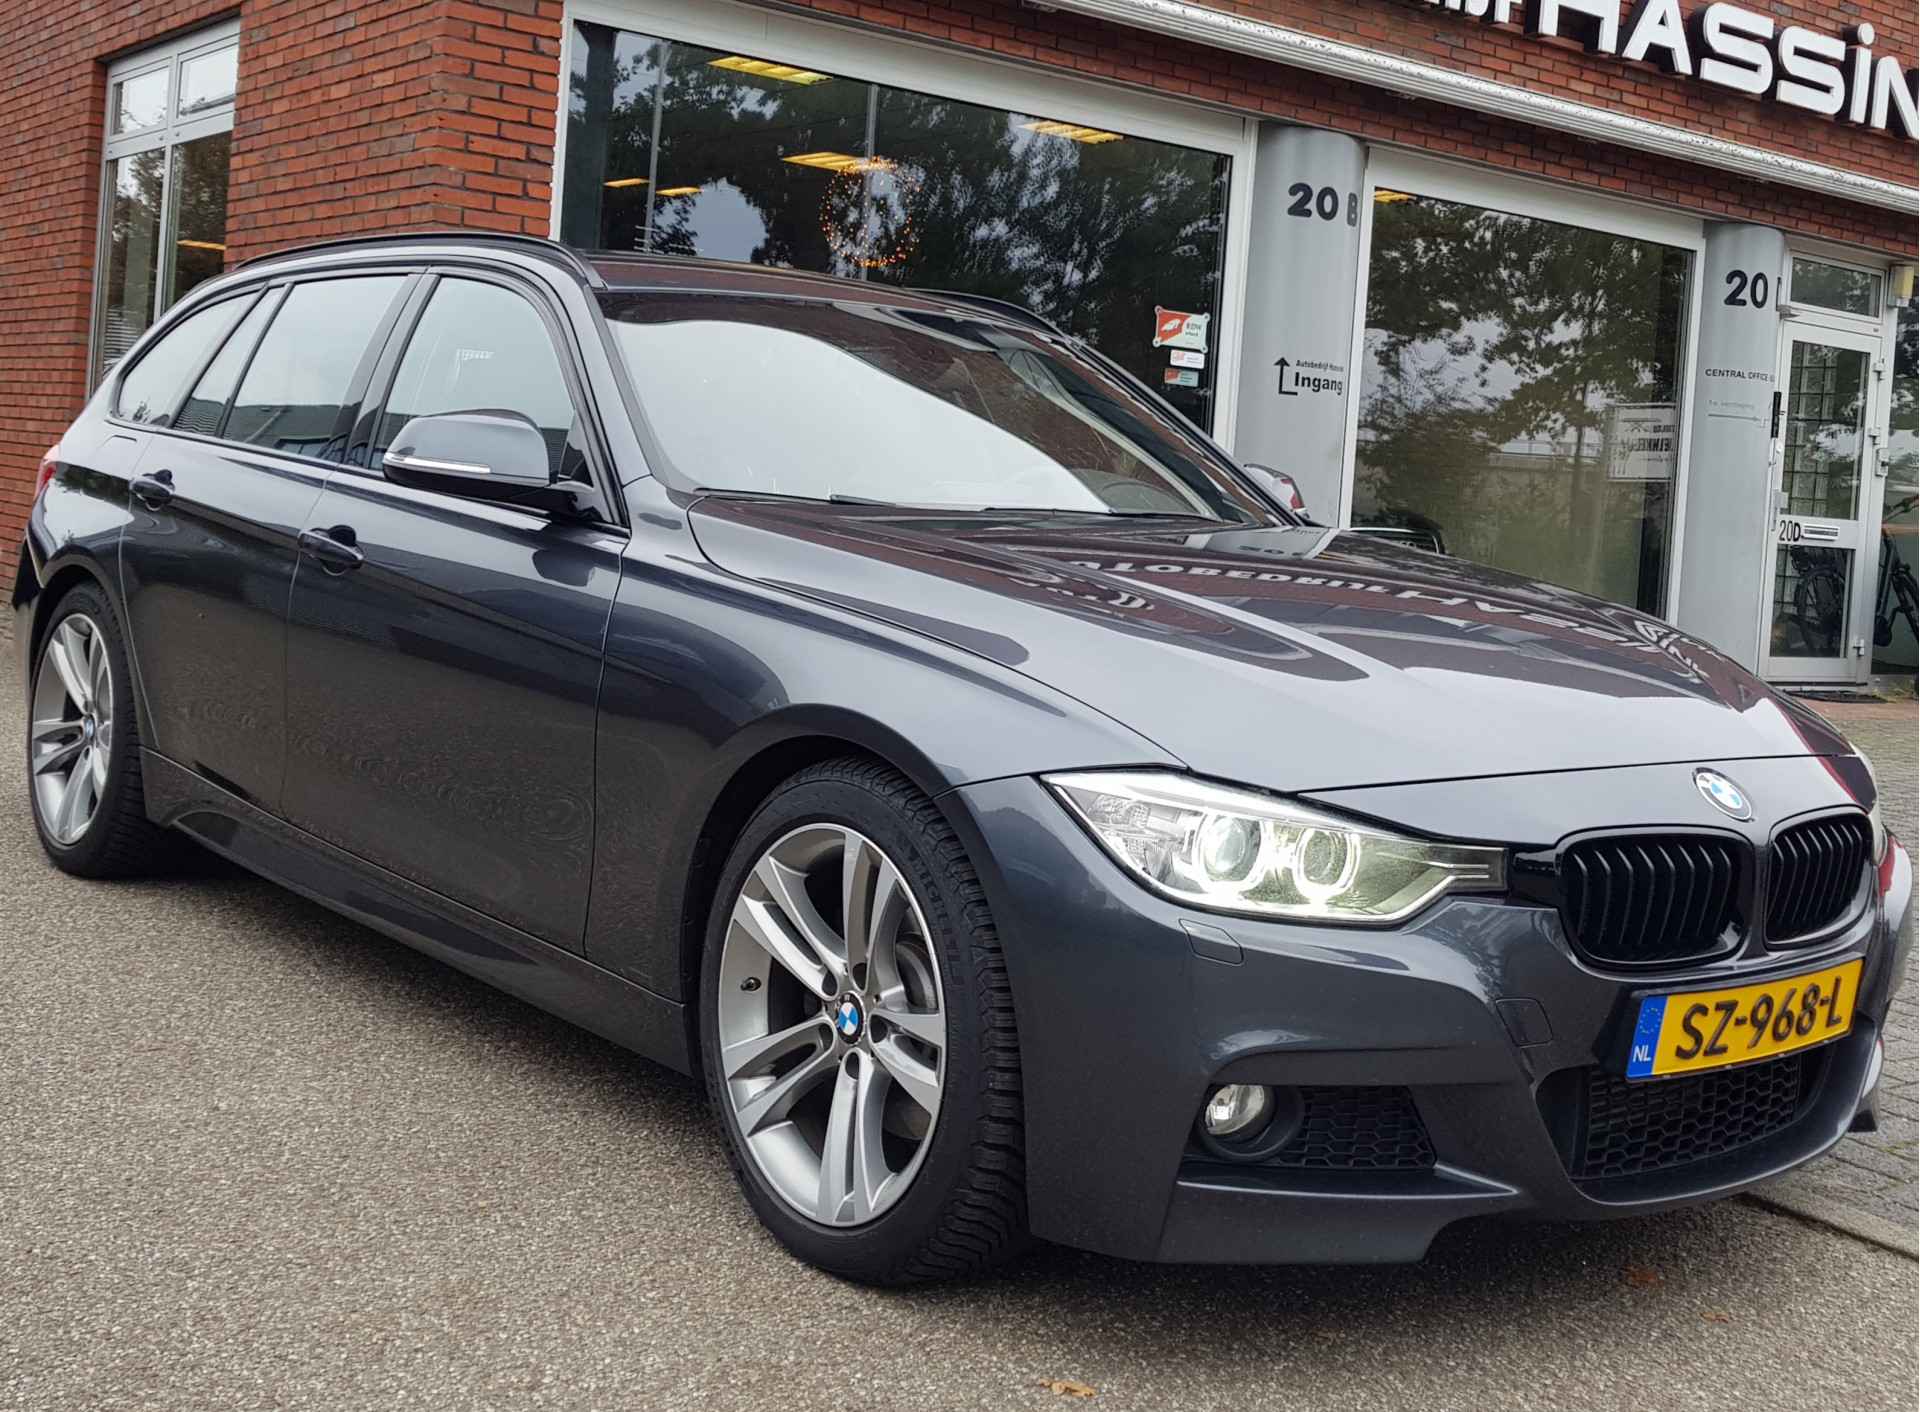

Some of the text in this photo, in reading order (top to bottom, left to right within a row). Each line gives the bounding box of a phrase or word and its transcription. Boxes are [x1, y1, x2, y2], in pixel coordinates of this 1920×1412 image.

[1287, 182, 1339, 221] 20
[1723, 269, 1769, 309] 20
[1294, 371, 1343, 396] Ingang
[1704, 368, 1746, 379] CENTRAL
[1779, 519, 1802, 542] 20D
[1674, 975, 1843, 1061] SZ-968-L
[1632, 1044, 1652, 1063] NL
